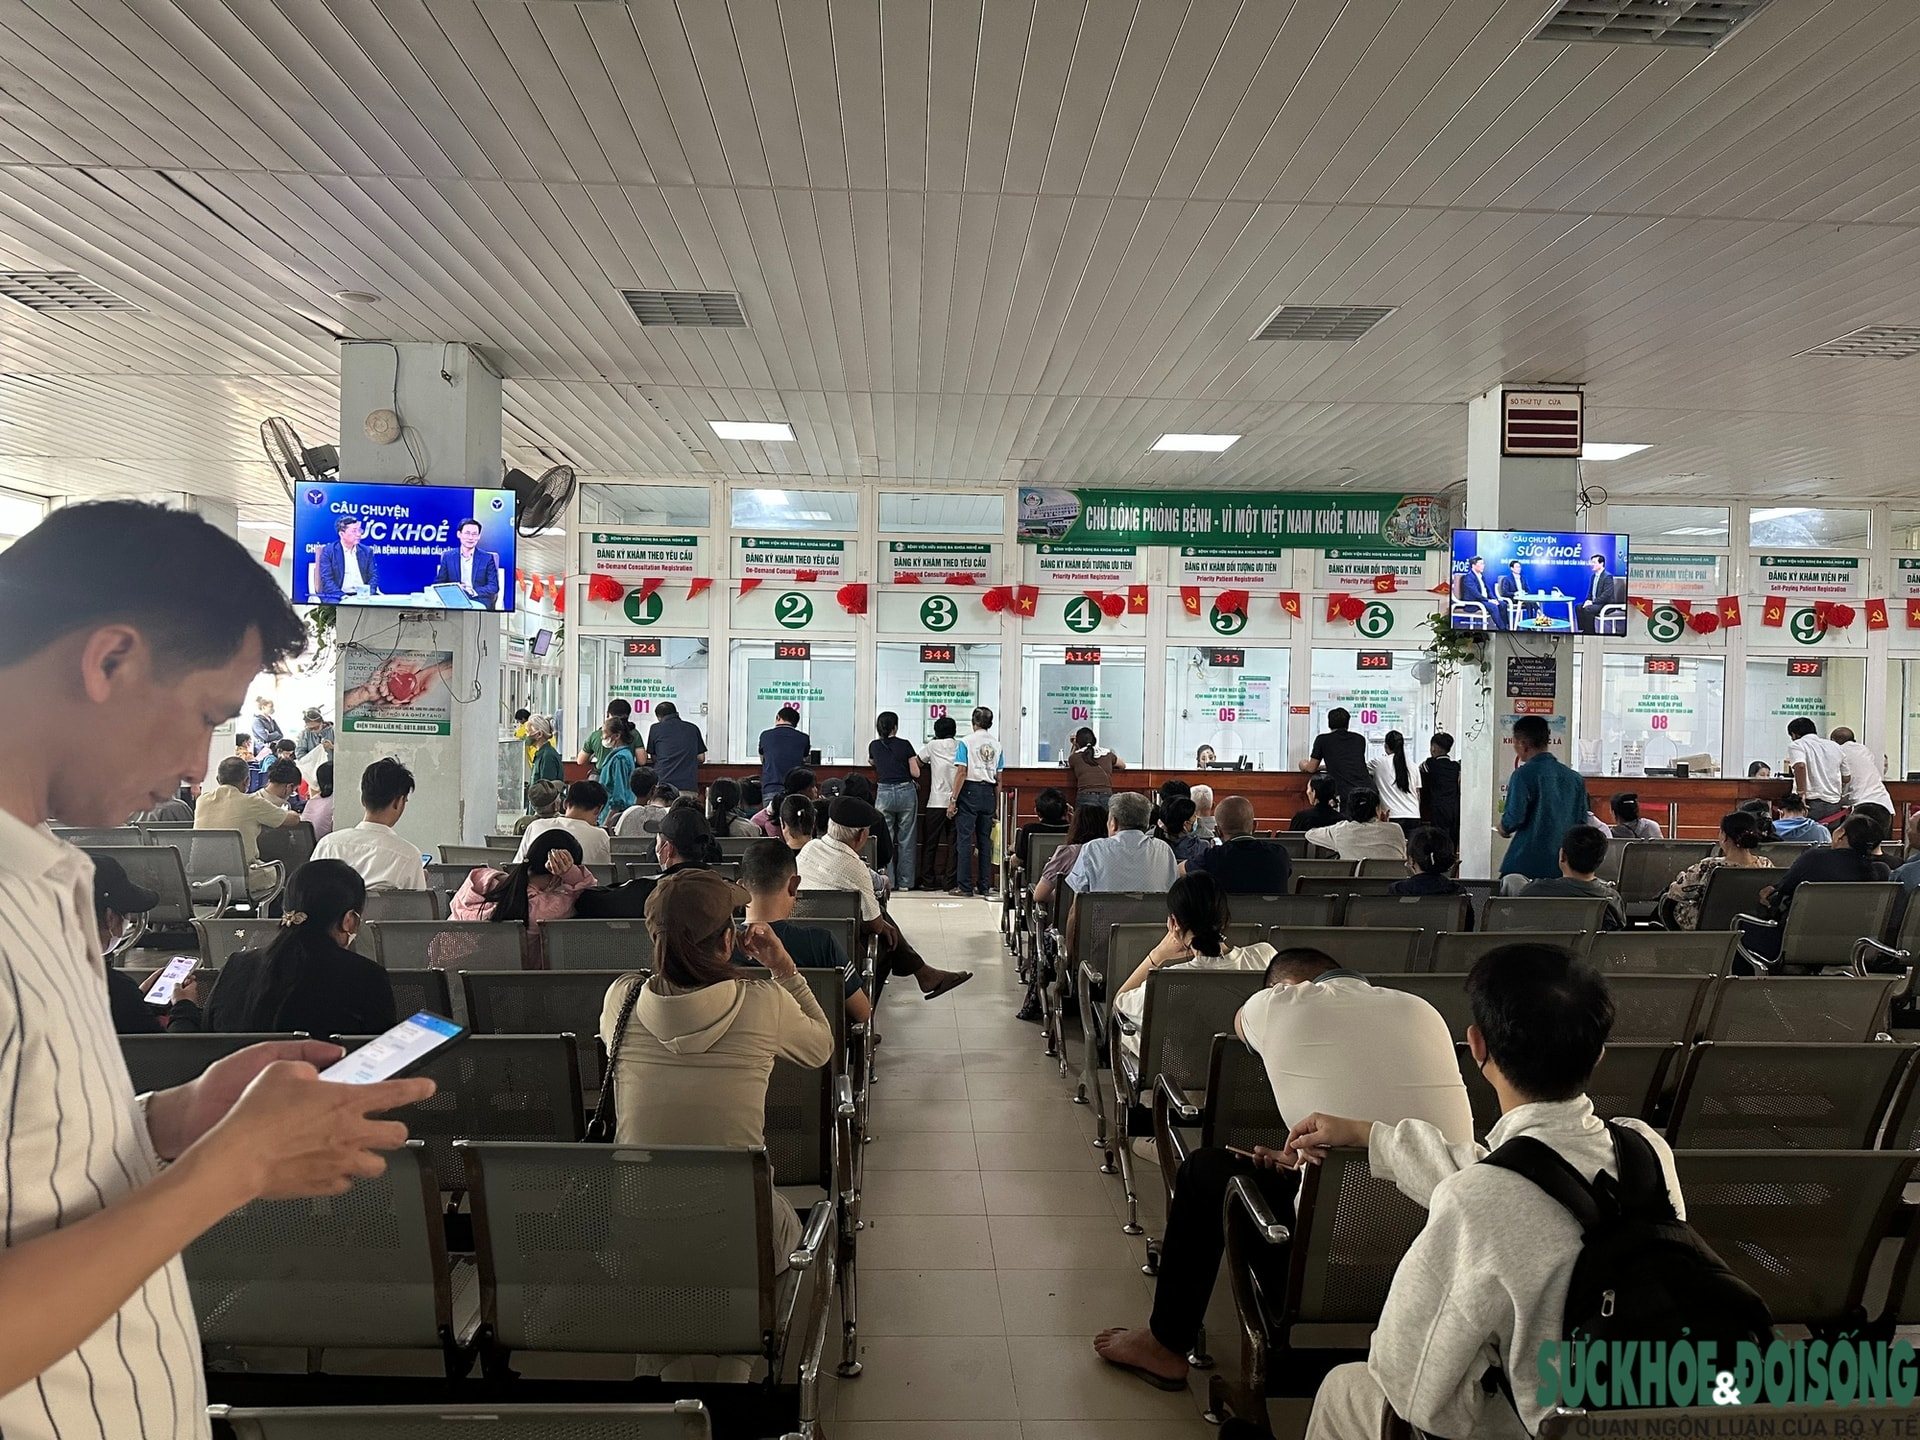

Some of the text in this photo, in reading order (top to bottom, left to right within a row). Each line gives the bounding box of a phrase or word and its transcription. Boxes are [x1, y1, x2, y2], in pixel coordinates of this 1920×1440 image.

[330, 502, 409, 519] CÂU CHUYỆN
[1086, 499, 1379, 539] CHỦ ĐỘNG PHÒNG BỆNH VÌ MỘT VIỆT NAM KHỎE MẠNH
[358, 517, 450, 542] ỨC KHOẺ
[1529, 536, 1557, 544] CHUYỆN
[597, 548, 692, 560] ĐĂNG KÝ KHÁM THEO YÊU CẦU
[1516, 543, 1582, 557] SỨC KHOẺ
[746, 552, 839, 565] ĐĂNG KÝ KHÁM THEO YÊU CẦU
[894, 556, 986, 567] ĐĂNG KÝ KHÁM THEO YÊU CẦU
[1041, 558, 1132, 572] ĐĂNG KÝ KHÁM ĐỐI TƯỢNG ƯU TIÊN
[1453, 558, 1470, 572] HOẺ
[1185, 560, 1276, 574] ĐĂNG KÝ KHÁM ĐỐI TƯỢNG ƯU TIÊN
[1329, 564, 1343, 573] ĐĂNG
[1345, 564, 1353, 573] KÝ
[1354, 565, 1369, 574] KHÁM
[1371, 563, 1380, 574] ĐỐI
[1400, 566, 1408, 574] ƯU
[1409, 565, 1421, 574] TIÊN
[1630, 568, 1644, 579] ĂNG
[1768, 570, 1849, 584] ĐĂNG KÝ KHÁM VIỆN PHÍ
[631, 592, 655, 620] 1
[780, 595, 807, 623] 2
[926, 598, 952, 627] 3
[1066, 598, 1094, 628] 4
[1360, 605, 1388, 634] 6
[1652, 610, 1680, 638] 8
[1796, 613, 1822, 641] 9
[629, 643, 656, 653] 324
[780, 647, 806, 656] 340
[924, 650, 950, 660] 344
[1066, 652, 1102, 661] A145
[1215, 654, 1240, 663] 345
[1362, 656, 1388, 666] 341
[1792, 663, 1819, 673] 337
[634, 699, 650, 713] 01
[930, 705, 947, 718] 03
[1071, 707, 1088, 720] 04
[1219, 708, 1235, 722] 05
[1361, 710, 1377, 724] 06
[1652, 715, 1668, 729] 08
